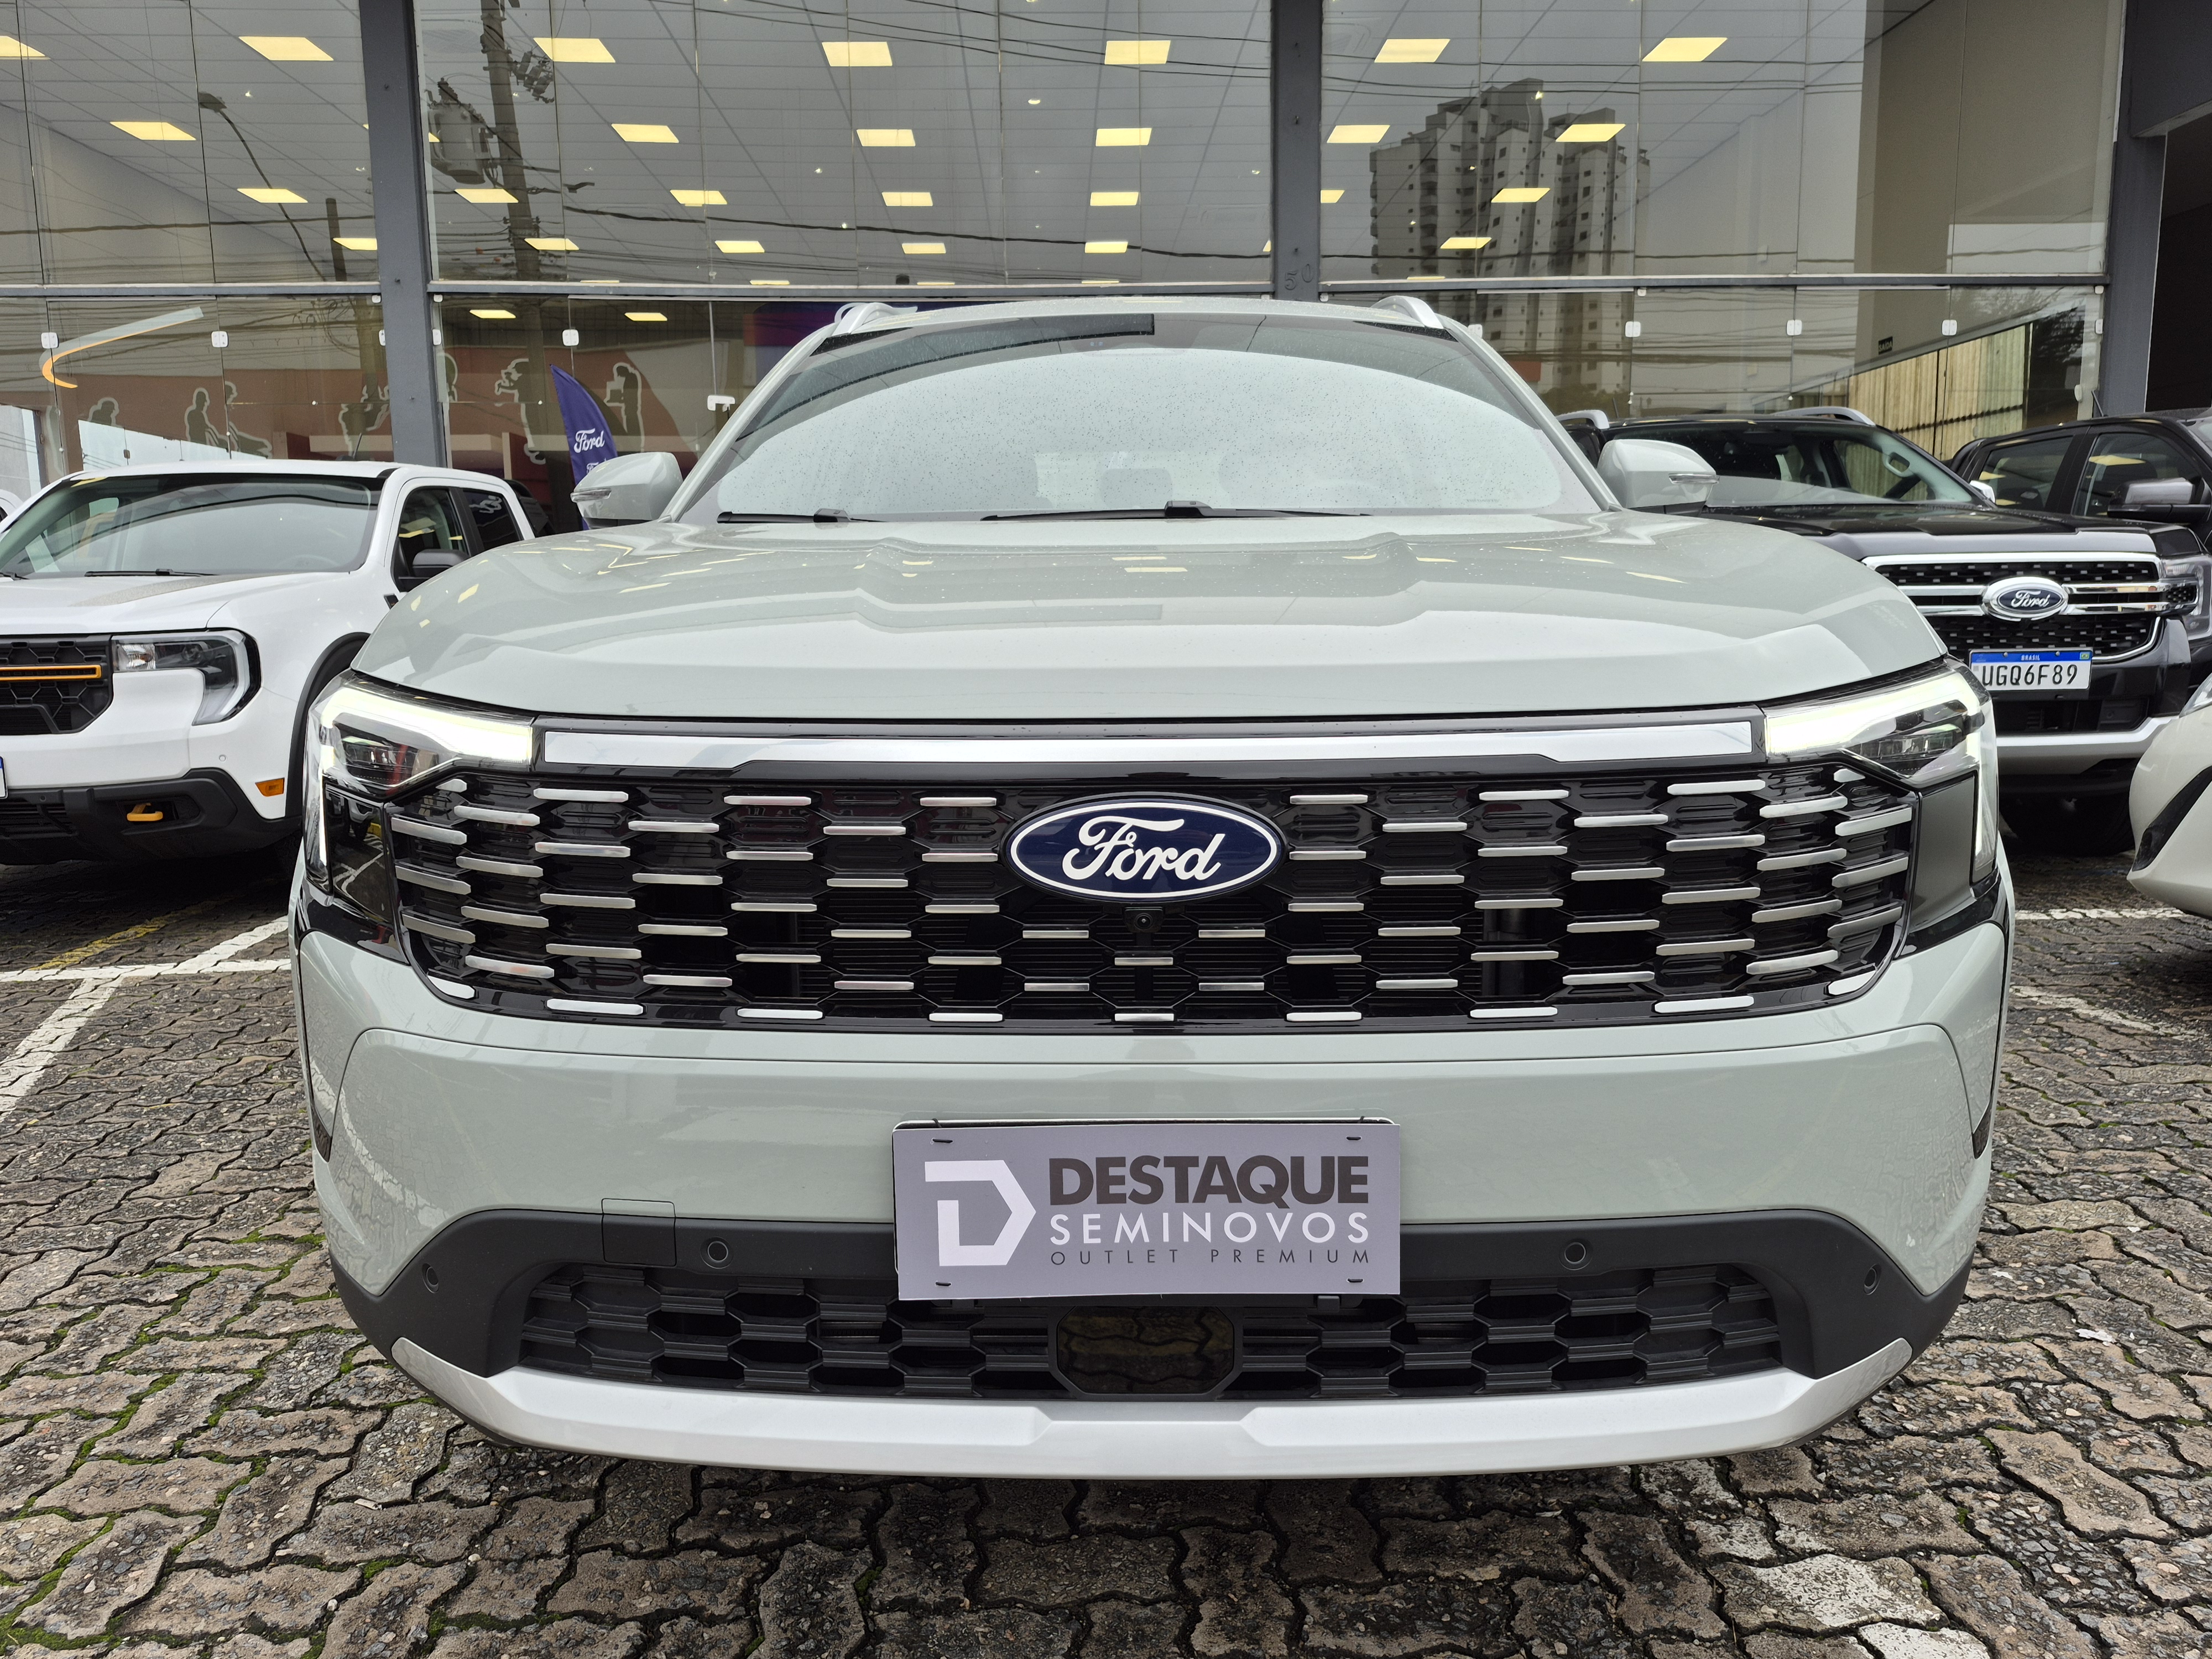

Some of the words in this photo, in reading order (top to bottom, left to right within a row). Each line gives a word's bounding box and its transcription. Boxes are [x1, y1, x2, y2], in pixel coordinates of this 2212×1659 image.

[573, 427, 606, 453] Ford
[2011, 590, 2051, 608] Ford
[1982, 664, 2078, 686] UGQ6F89
[1062, 816, 1225, 880] Ford
[1049, 1155, 1369, 1209] DESTAQUE
[1050, 1212, 1369, 1245] SEMINOVOS
[1051, 1249, 1178, 1265] OUTLET
[1211, 1249, 1370, 1265] PREMIUM
